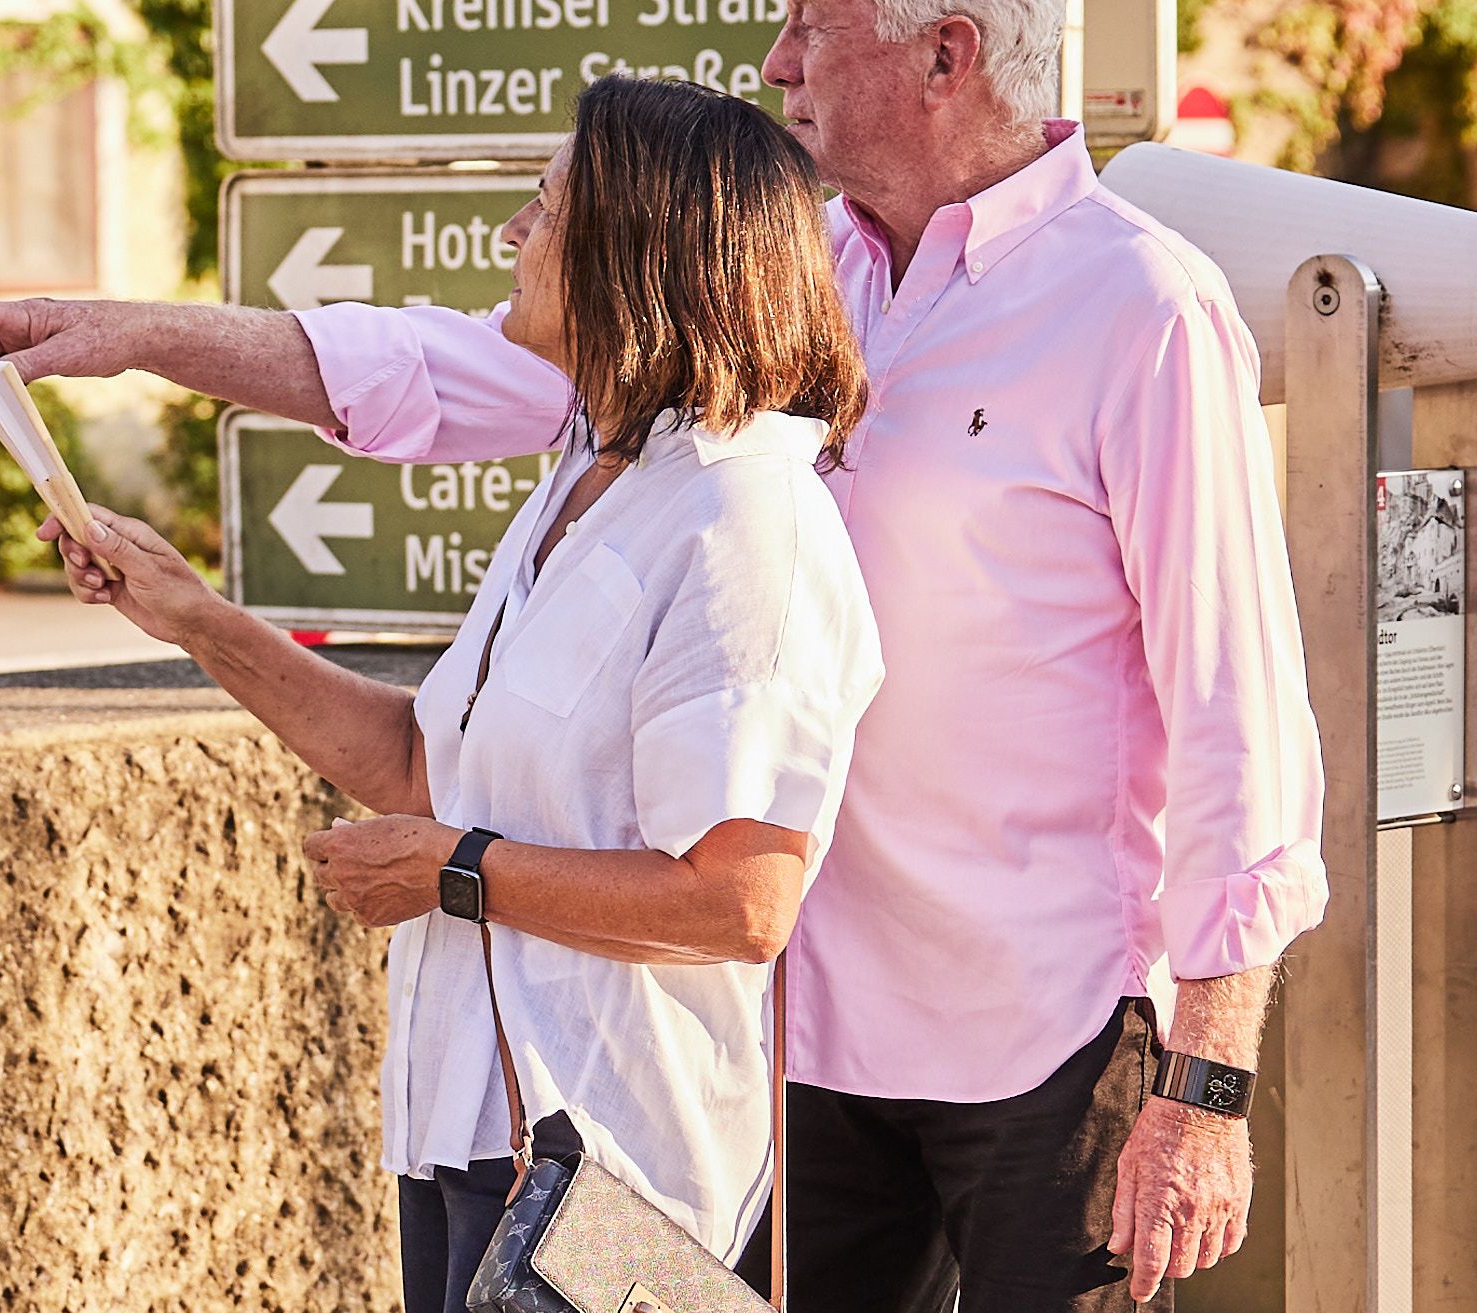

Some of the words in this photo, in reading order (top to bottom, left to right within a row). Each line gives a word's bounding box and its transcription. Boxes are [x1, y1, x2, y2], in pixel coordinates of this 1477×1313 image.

[399, 52, 564, 117] Linzer
[402, 210, 520, 271] Hote
[405, 531, 499, 595] Mis
